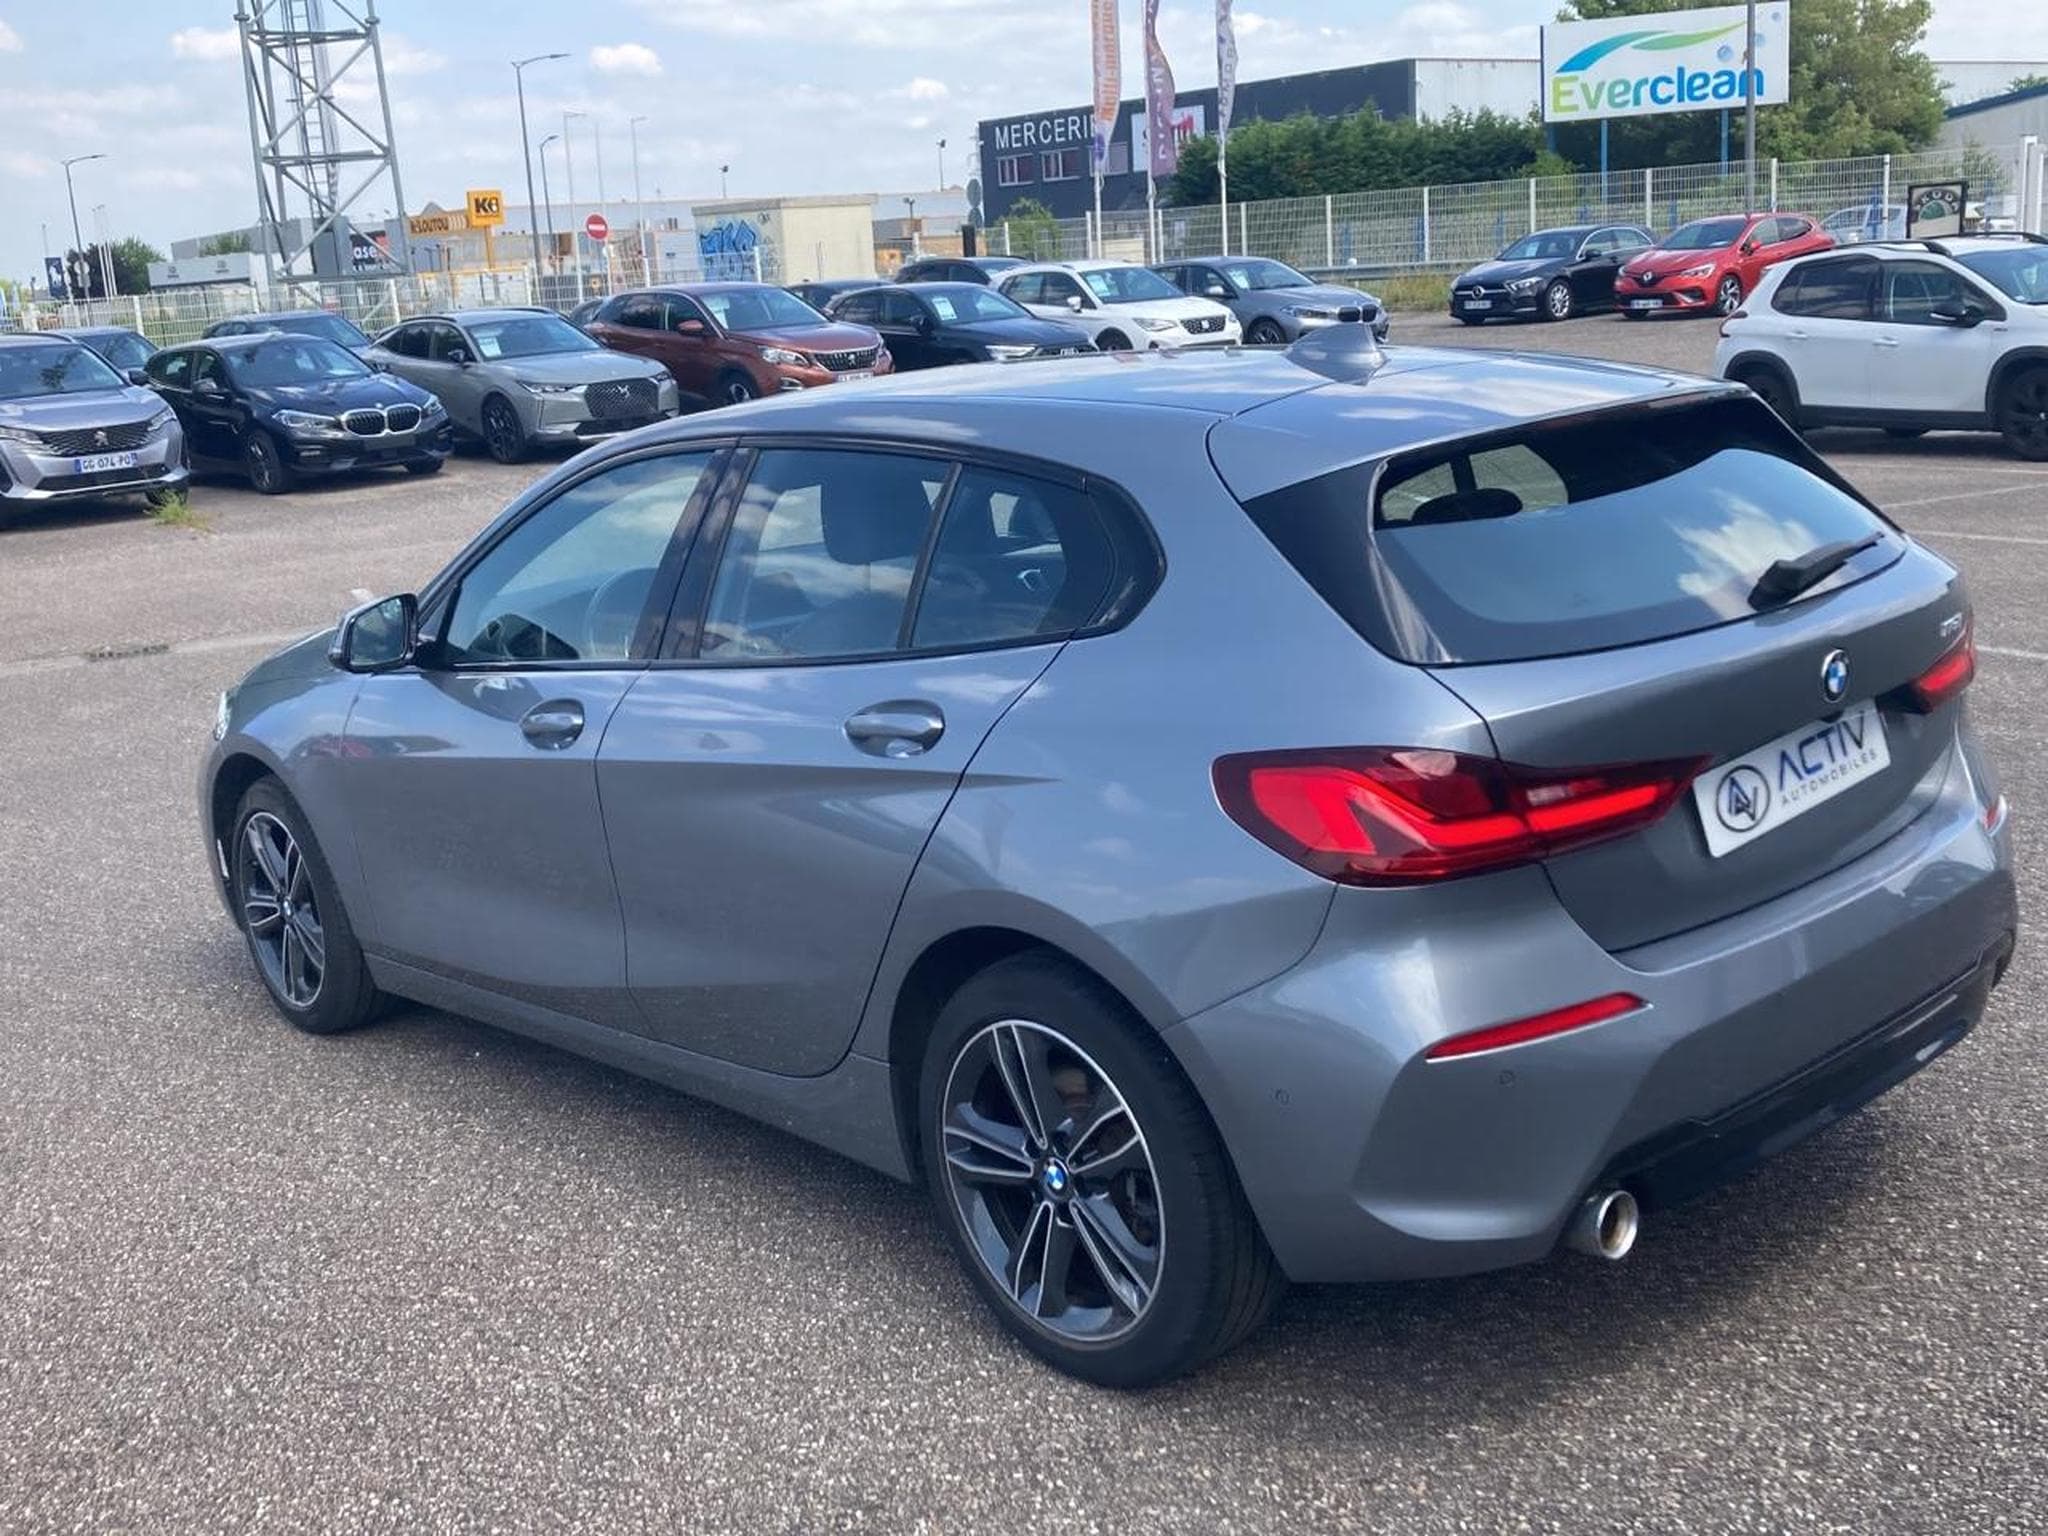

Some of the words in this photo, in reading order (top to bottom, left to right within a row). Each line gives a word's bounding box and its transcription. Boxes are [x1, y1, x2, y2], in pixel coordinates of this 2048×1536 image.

[1552, 66, 1764, 114] Everclean
[1779, 711, 1865, 791] ACTIV
[1781, 749, 1878, 806] AUTOMOBILES
